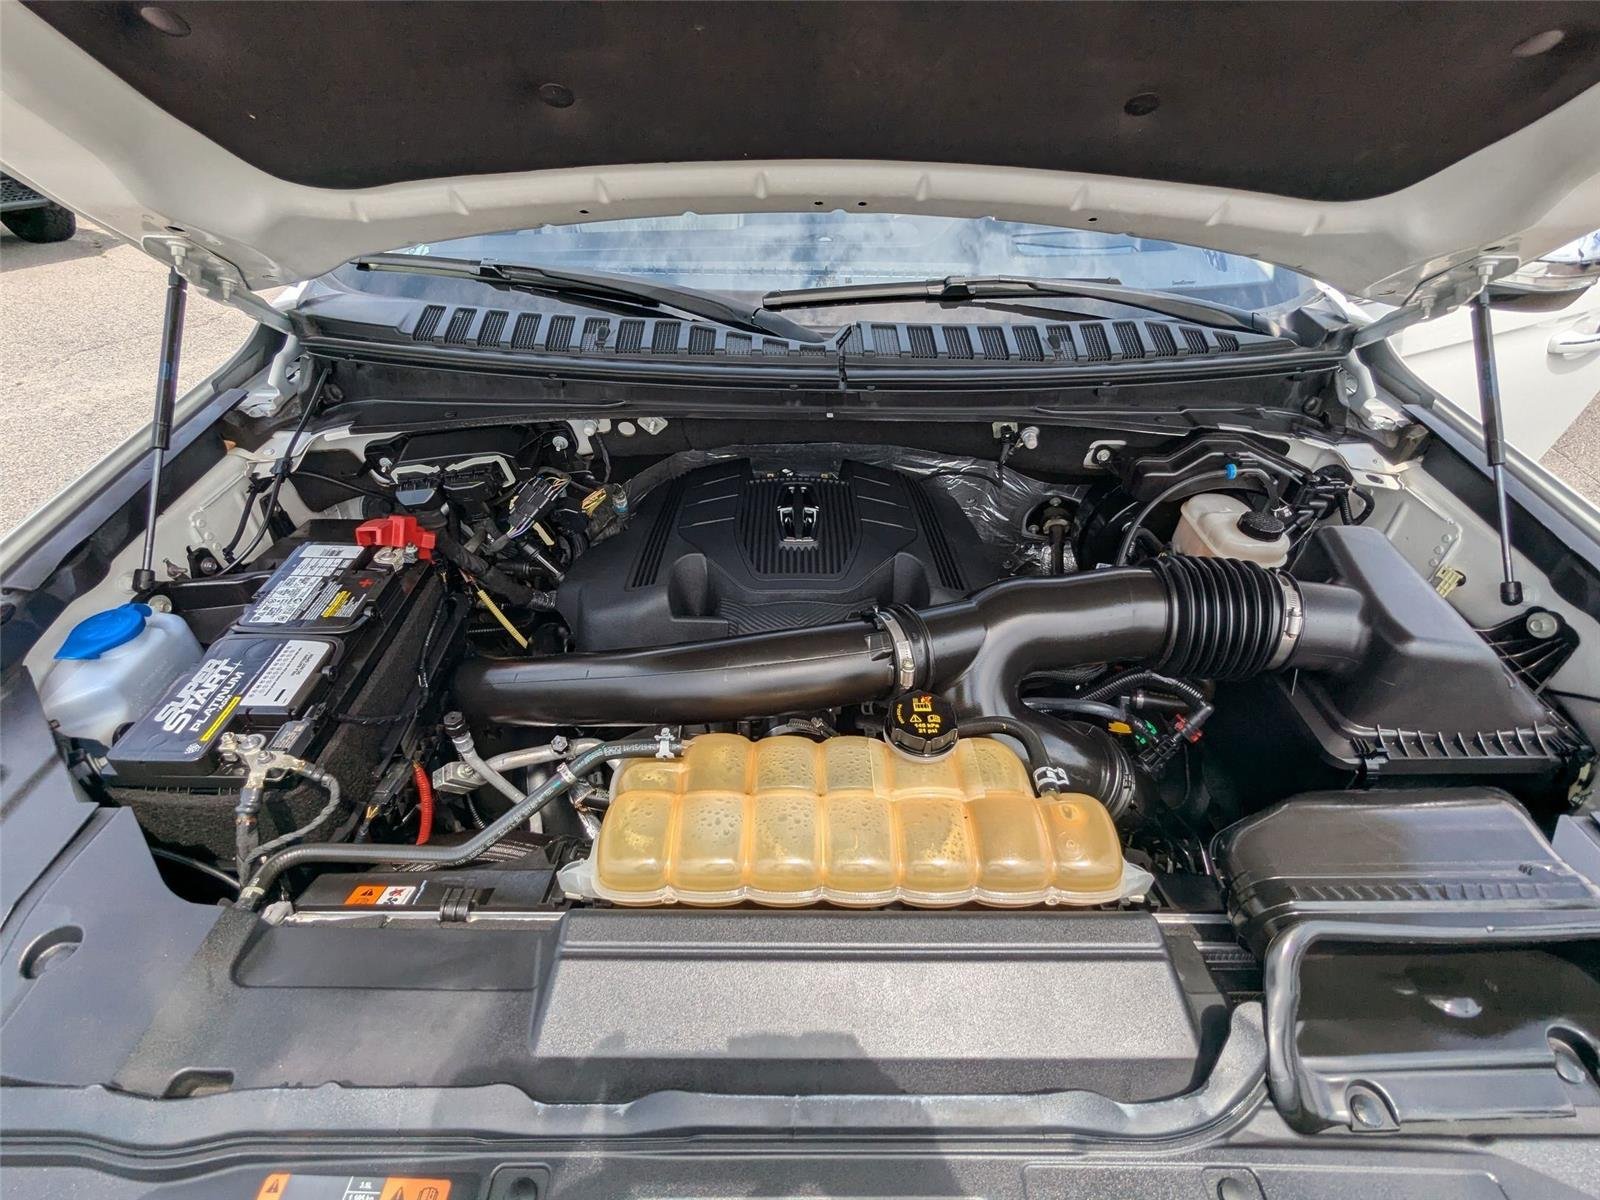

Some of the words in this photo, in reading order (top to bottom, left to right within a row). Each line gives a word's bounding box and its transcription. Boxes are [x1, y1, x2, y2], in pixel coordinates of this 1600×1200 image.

[154, 658, 222, 722] SUPER
[163, 658, 235, 734] START
[189, 671, 245, 732] PLATINUM
